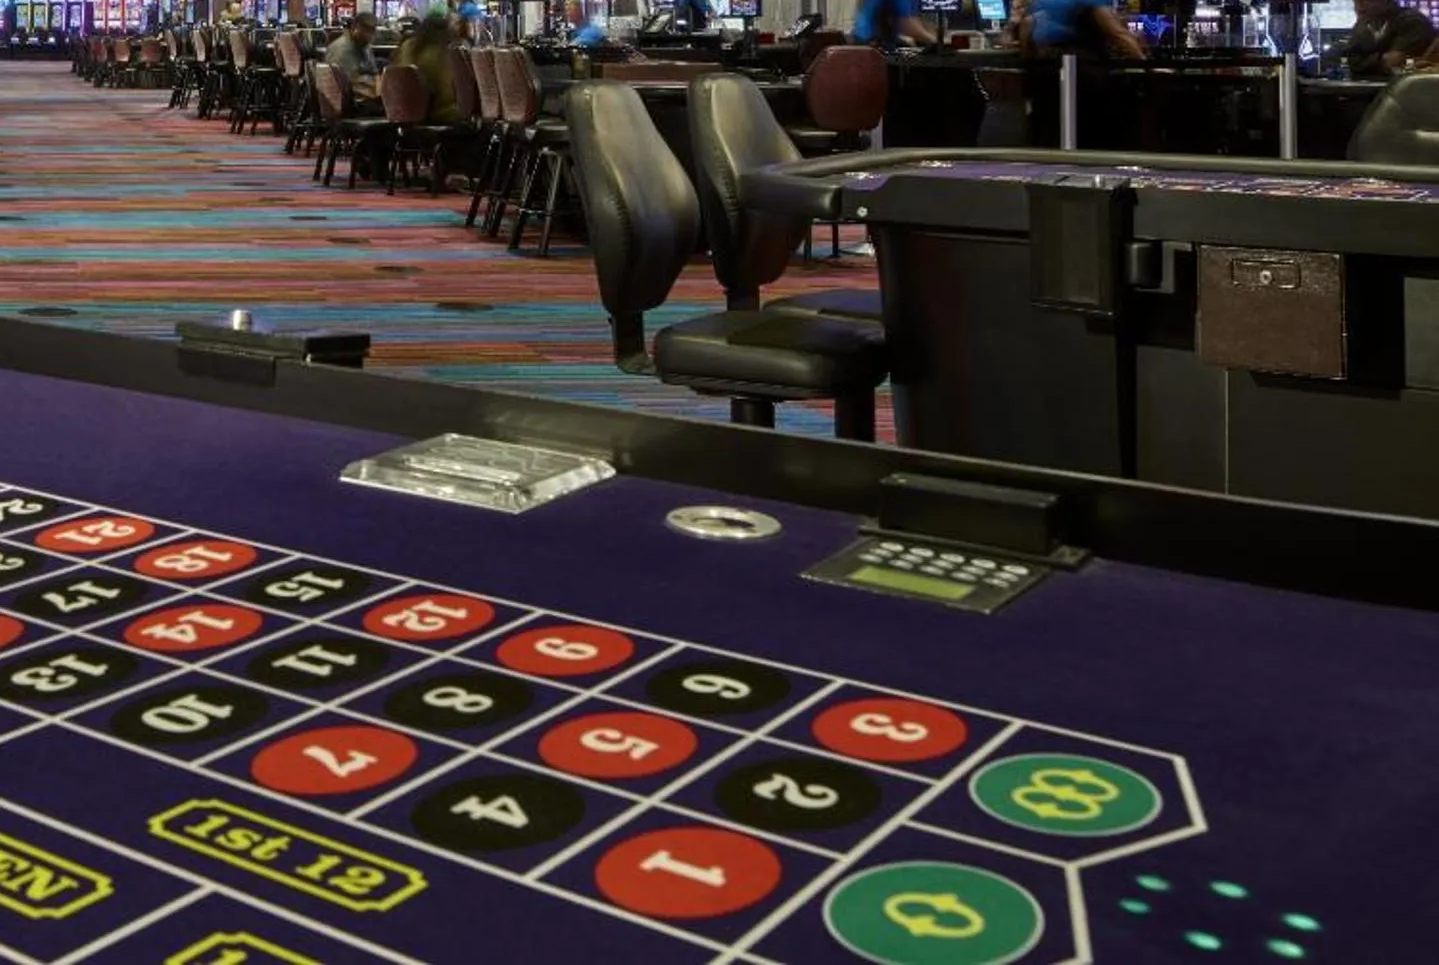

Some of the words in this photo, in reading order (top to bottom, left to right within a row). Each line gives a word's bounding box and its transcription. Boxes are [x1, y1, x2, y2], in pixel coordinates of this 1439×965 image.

[54, 520, 136, 545] 21
[154, 546, 232, 573] 18
[43, 581, 120, 613] 17
[266, 572, 343, 602] 15
[141, 611, 233, 643] 14
[383, 601, 467, 632] 12
[273, 645, 356, 676] 11
[535, 638, 598, 660] 9
[11, 655, 108, 691] 13
[683, 675, 750, 699] 6
[142, 694, 232, 733] 10
[423, 687, 493, 713] 8
[851, 714, 928, 742] 3
[581, 729, 658, 759] 5
[304, 746, 376, 777] 7
[754, 774, 838, 808] 2
[451, 796, 528, 828] 4
[183, 815, 292, 861] 1st
[295, 853, 386, 895] 12
[641, 851, 725, 886] 1
